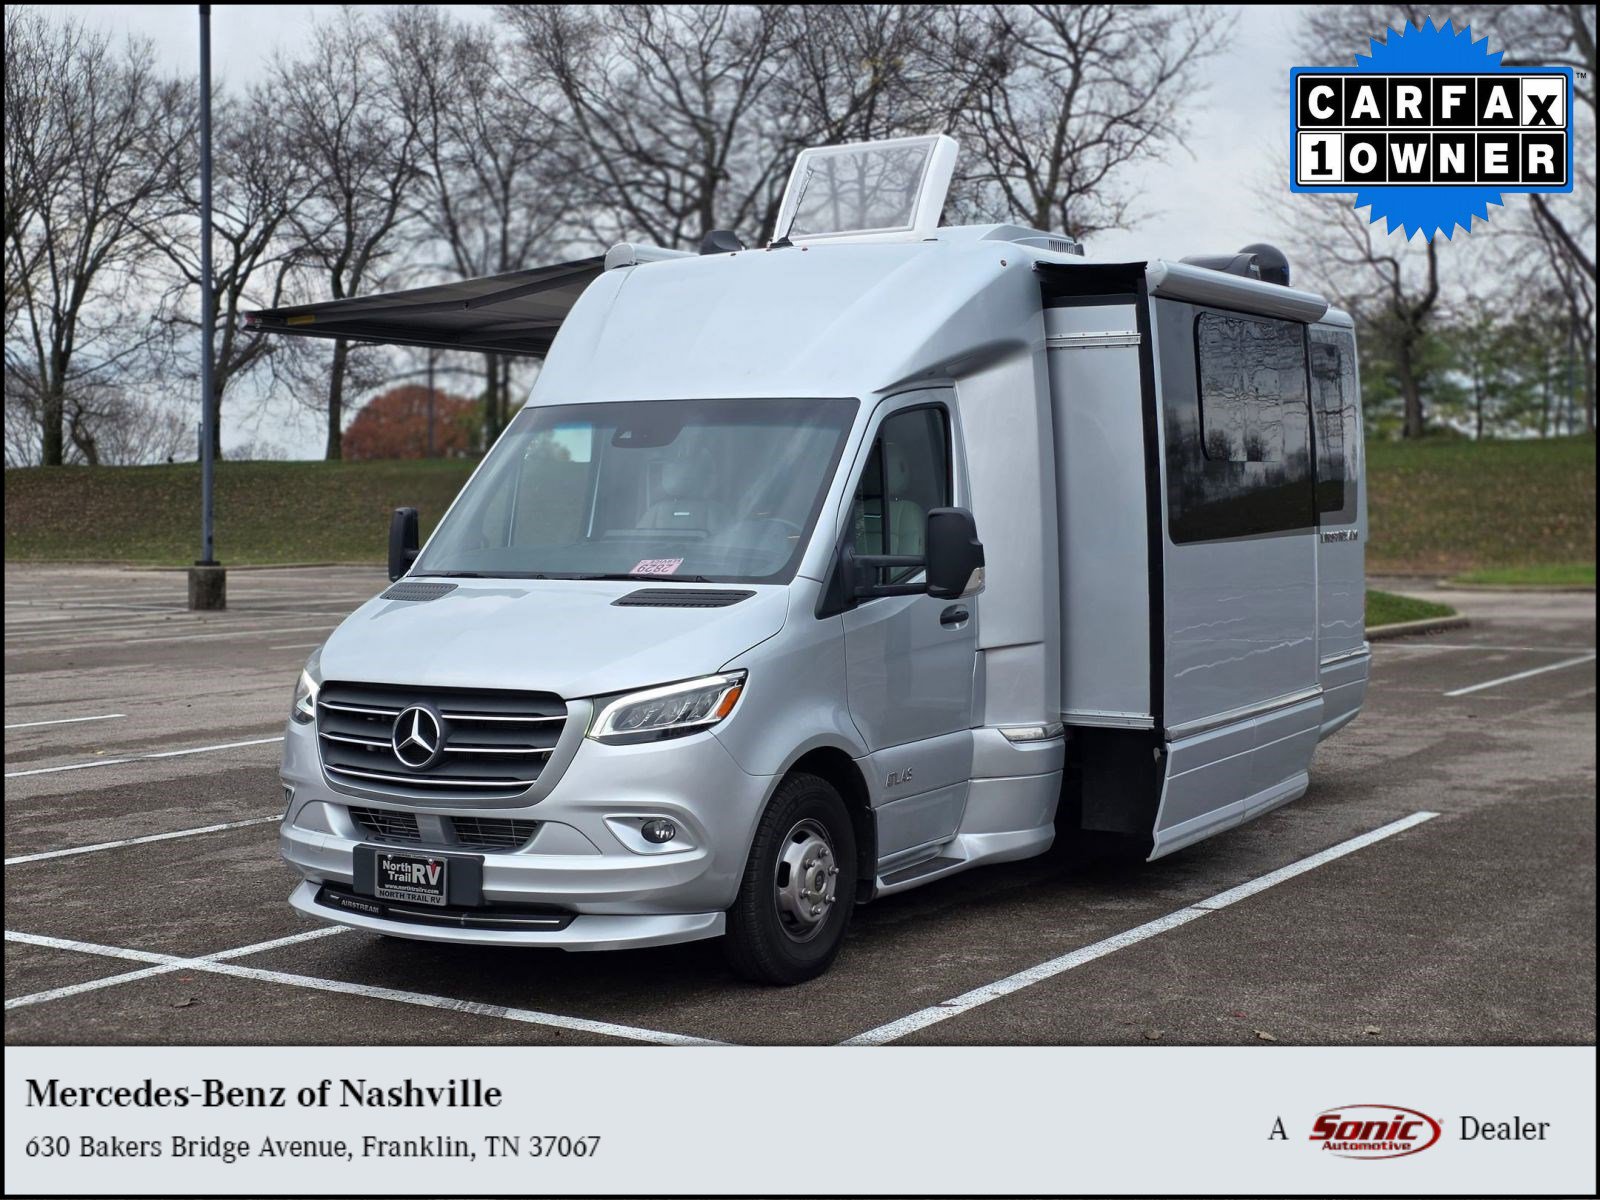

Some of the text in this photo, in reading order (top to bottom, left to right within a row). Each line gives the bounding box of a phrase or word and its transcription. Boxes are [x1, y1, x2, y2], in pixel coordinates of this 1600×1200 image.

[637, 564, 673, 573] 2829
[382, 860, 411, 872] North
[388, 871, 411, 882] Trail
[412, 863, 441, 886] RV
[380, 889, 441, 904] NORTH TRAIL RV
[341, 899, 379, 913] AIRSTREAM
